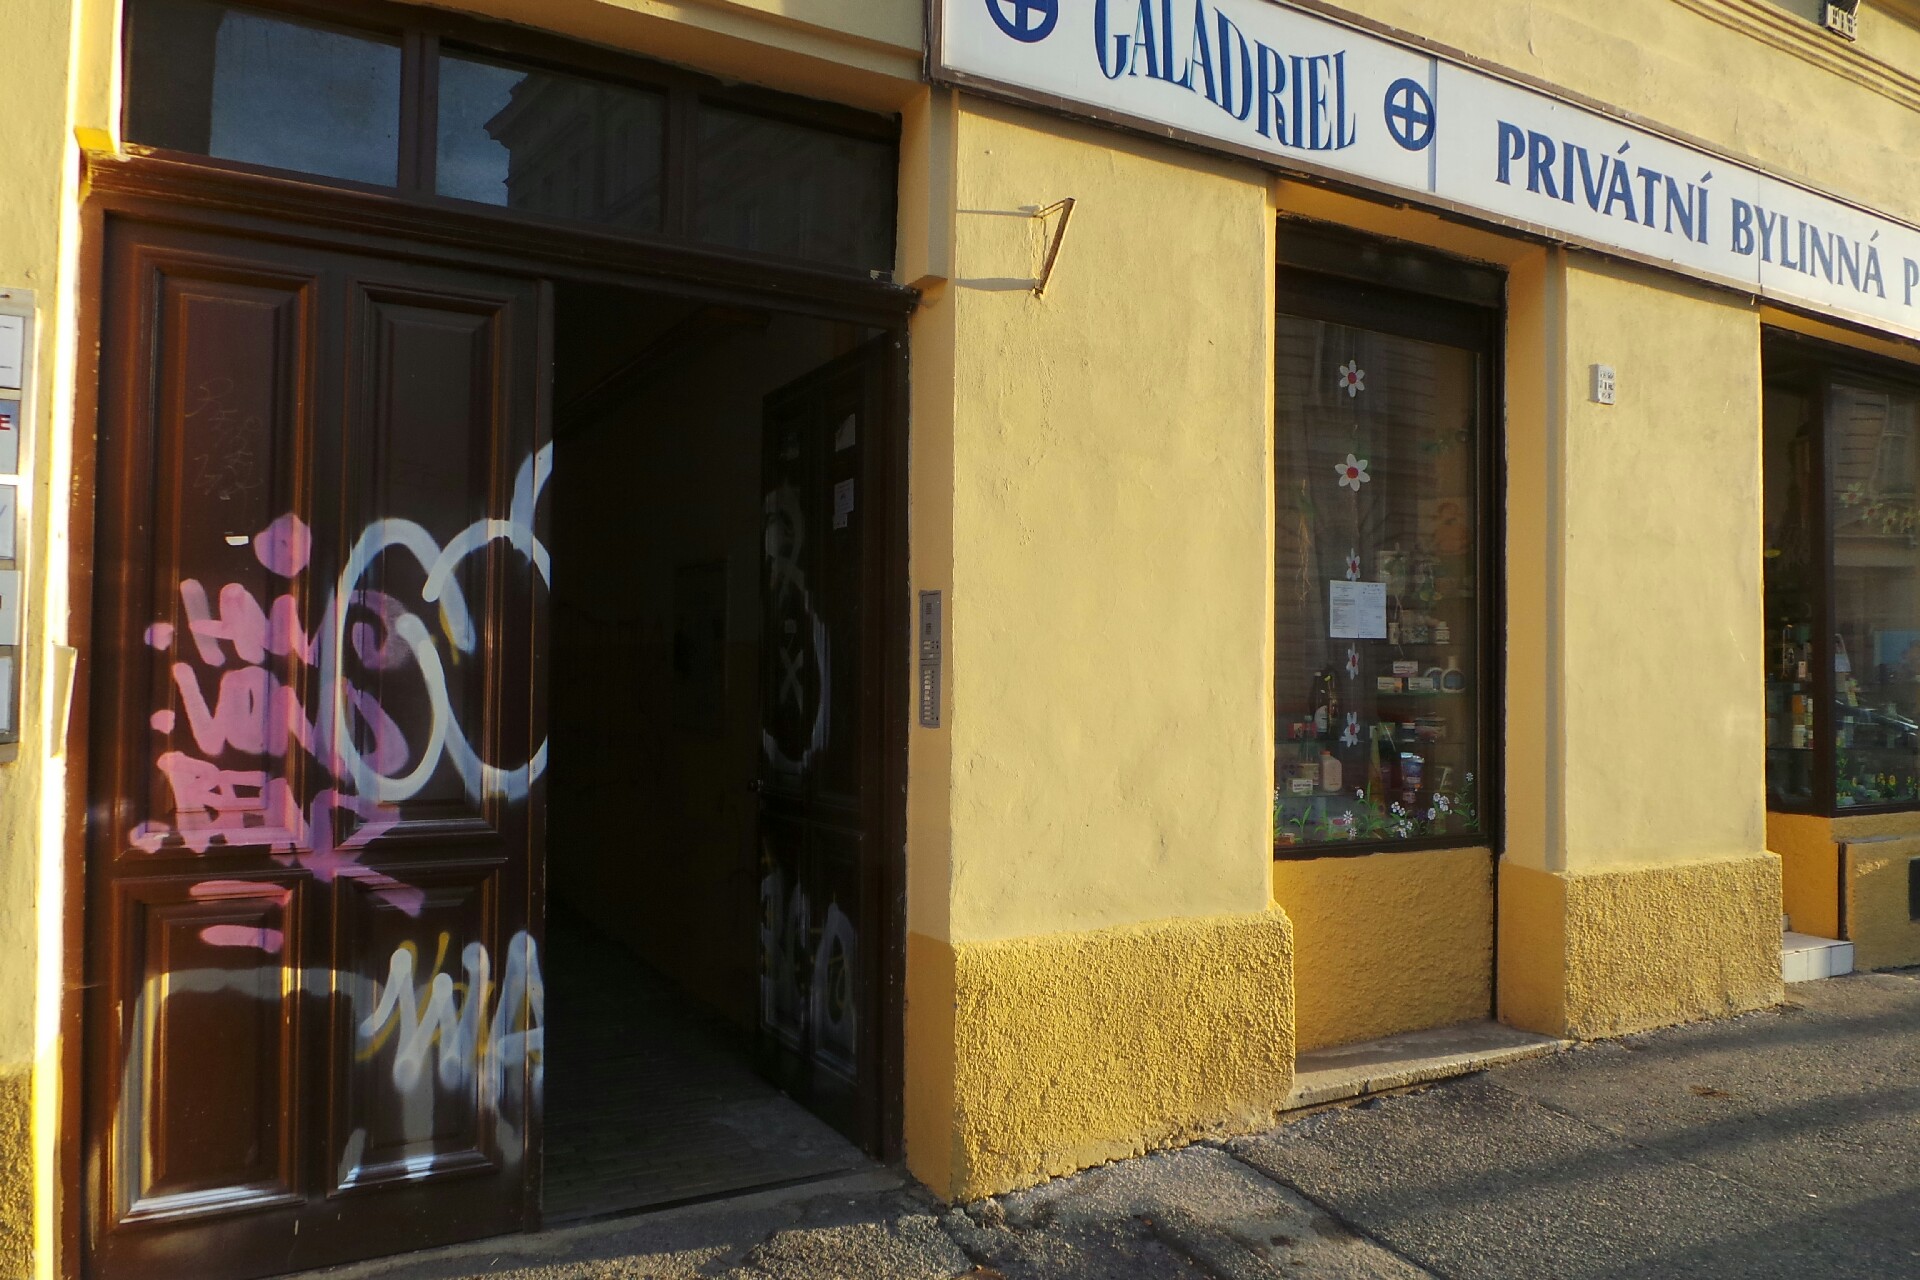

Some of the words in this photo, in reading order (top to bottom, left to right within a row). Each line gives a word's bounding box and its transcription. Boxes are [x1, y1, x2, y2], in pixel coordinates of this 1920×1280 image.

[1094, 0, 1356, 151] GALADRIEL
[1495, 119, 1713, 246] PRIVÁTNÍ
[1730, 196, 1887, 300] BYLINNÁ
